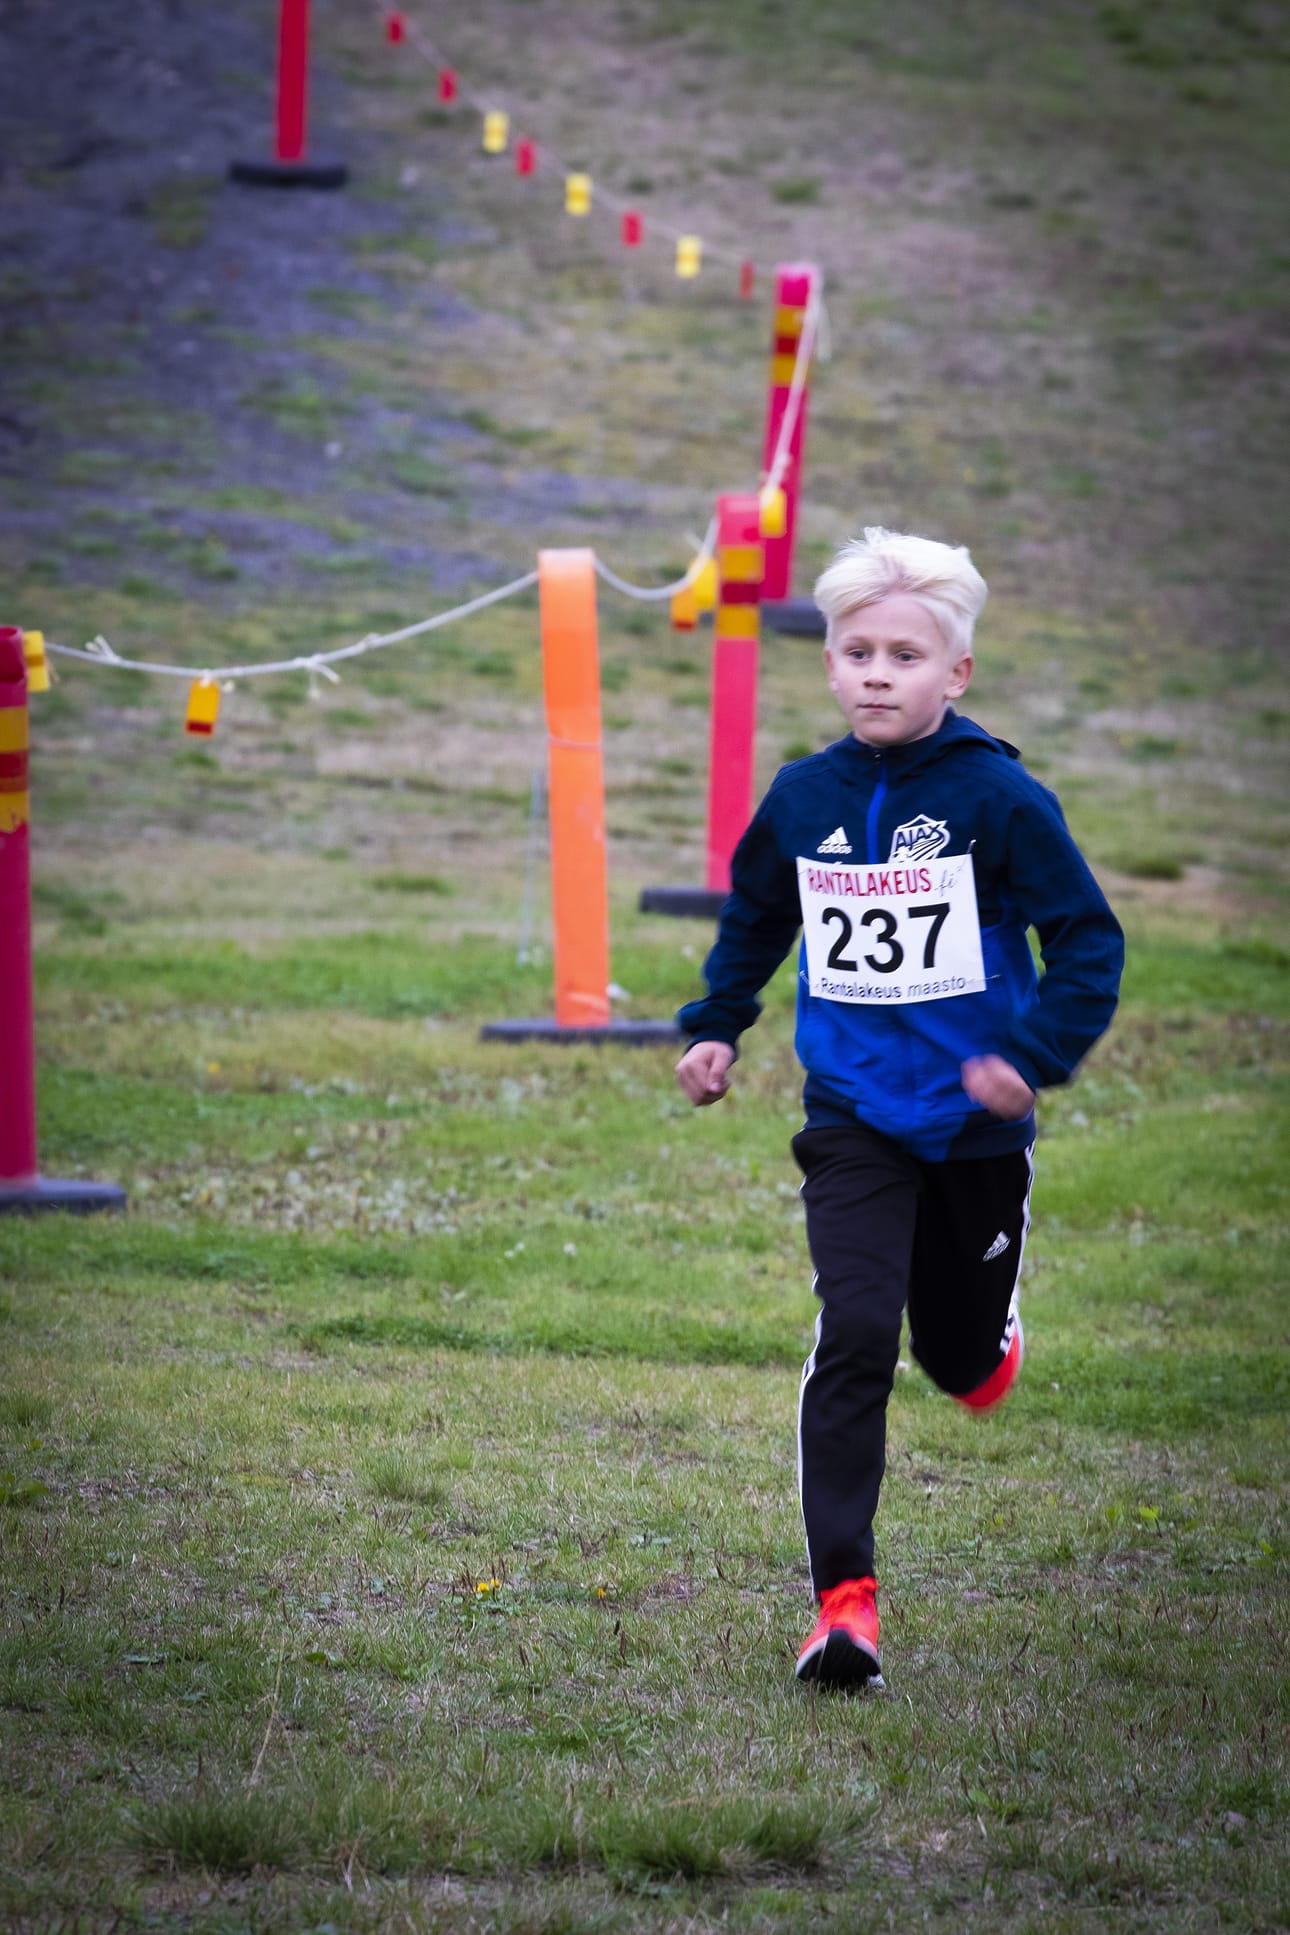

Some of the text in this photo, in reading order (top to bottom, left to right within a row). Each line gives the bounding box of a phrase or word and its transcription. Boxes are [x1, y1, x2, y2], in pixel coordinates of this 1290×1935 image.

[817, 844, 853, 854] adidas
[895, 826, 941, 851] AJAX
[808, 868, 931, 896] RANTALAKEUS
[822, 902, 950, 973] 237
[820, 976, 967, 998] Rantalakeus maasto
